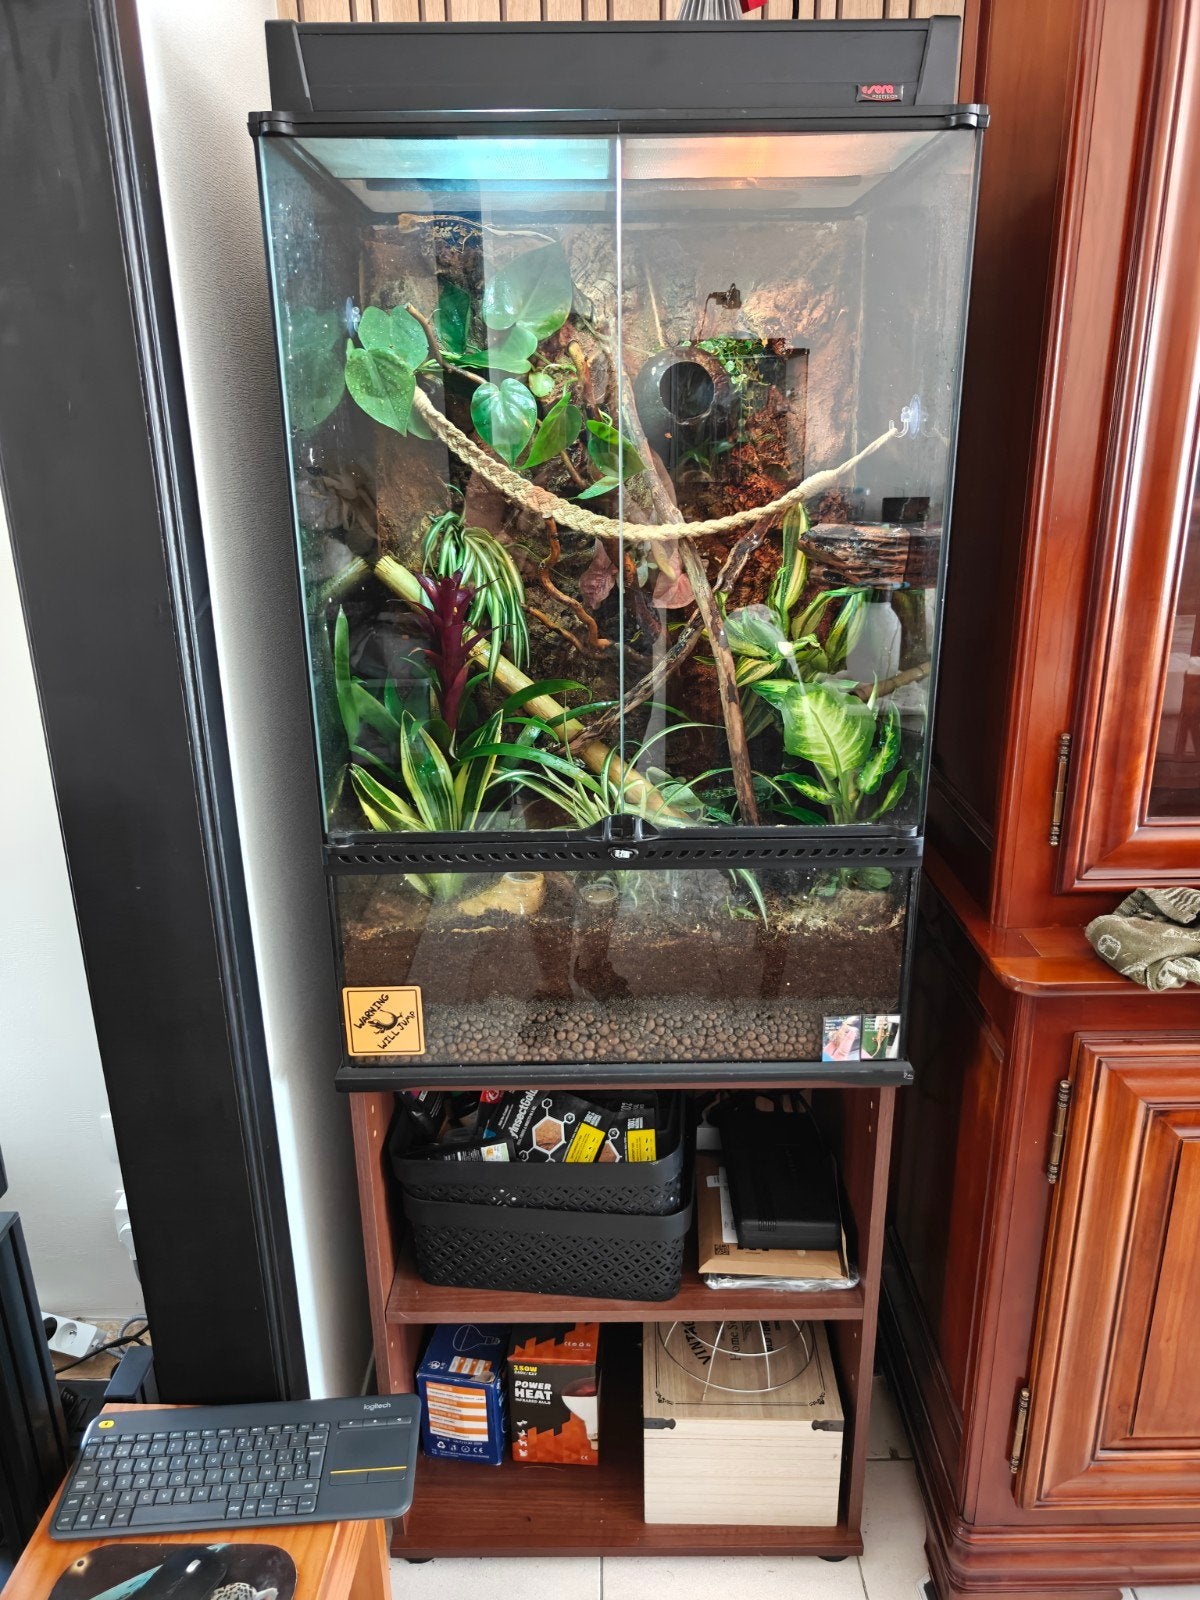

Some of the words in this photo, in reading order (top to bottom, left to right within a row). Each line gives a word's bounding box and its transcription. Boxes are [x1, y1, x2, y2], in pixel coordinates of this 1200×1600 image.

[353, 994, 389, 1029] WARNING
[377, 1031, 399, 1049] WILL
[397, 1011, 415, 1031] JUMP
[729, 1332, 741, 1360] Home
[514, 1388, 553, 1401] HEAT
[515, 1380, 552, 1390] POWER
[363, 1402, 392, 1411] logitech
